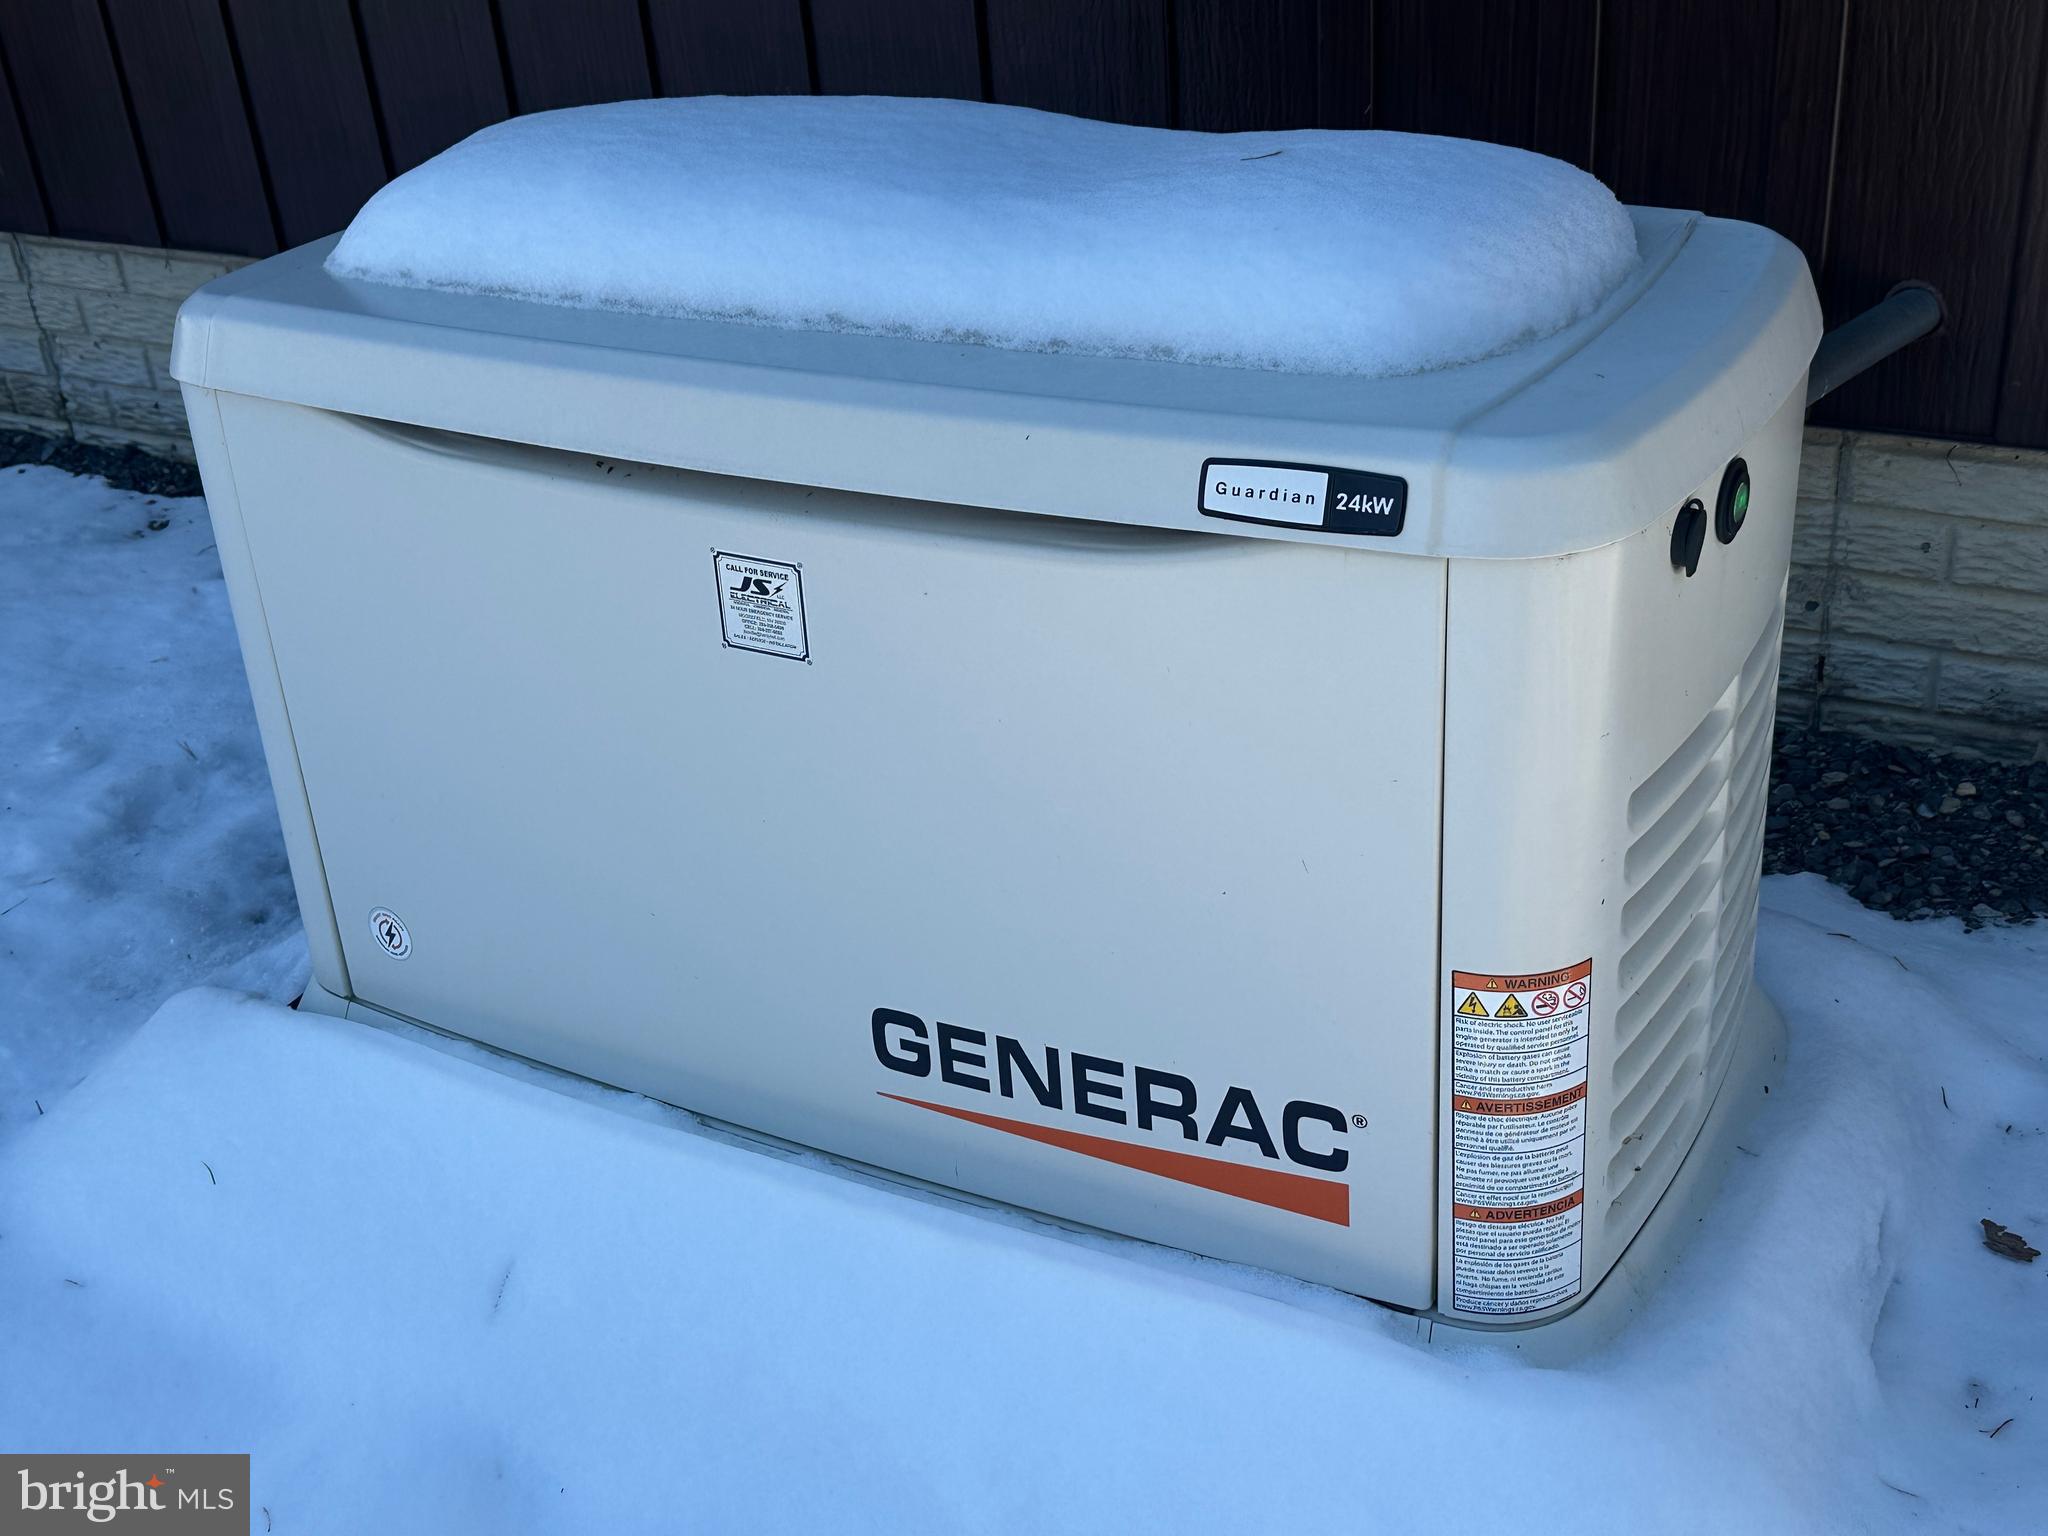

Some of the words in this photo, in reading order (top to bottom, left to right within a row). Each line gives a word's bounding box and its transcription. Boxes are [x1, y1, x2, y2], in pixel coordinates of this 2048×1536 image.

[1215, 481, 1316, 505] Guardian
[1335, 493, 1394, 516] 24kW
[725, 563, 743, 573] CALL
[744, 566, 758, 575] FOR
[759, 569, 790, 582] SERVICE
[729, 576, 772, 597] JS
[1504, 972, 1570, 990] WARNING
[1479, 1035, 1511, 1044] generator
[1534, 1025, 1552, 1035] panel
[871, 1006, 1350, 1173] GENERAC
[1476, 1087, 1585, 1113] AVERTISSEMENT
[1485, 1196, 1576, 1220] ADVERTENCIA
